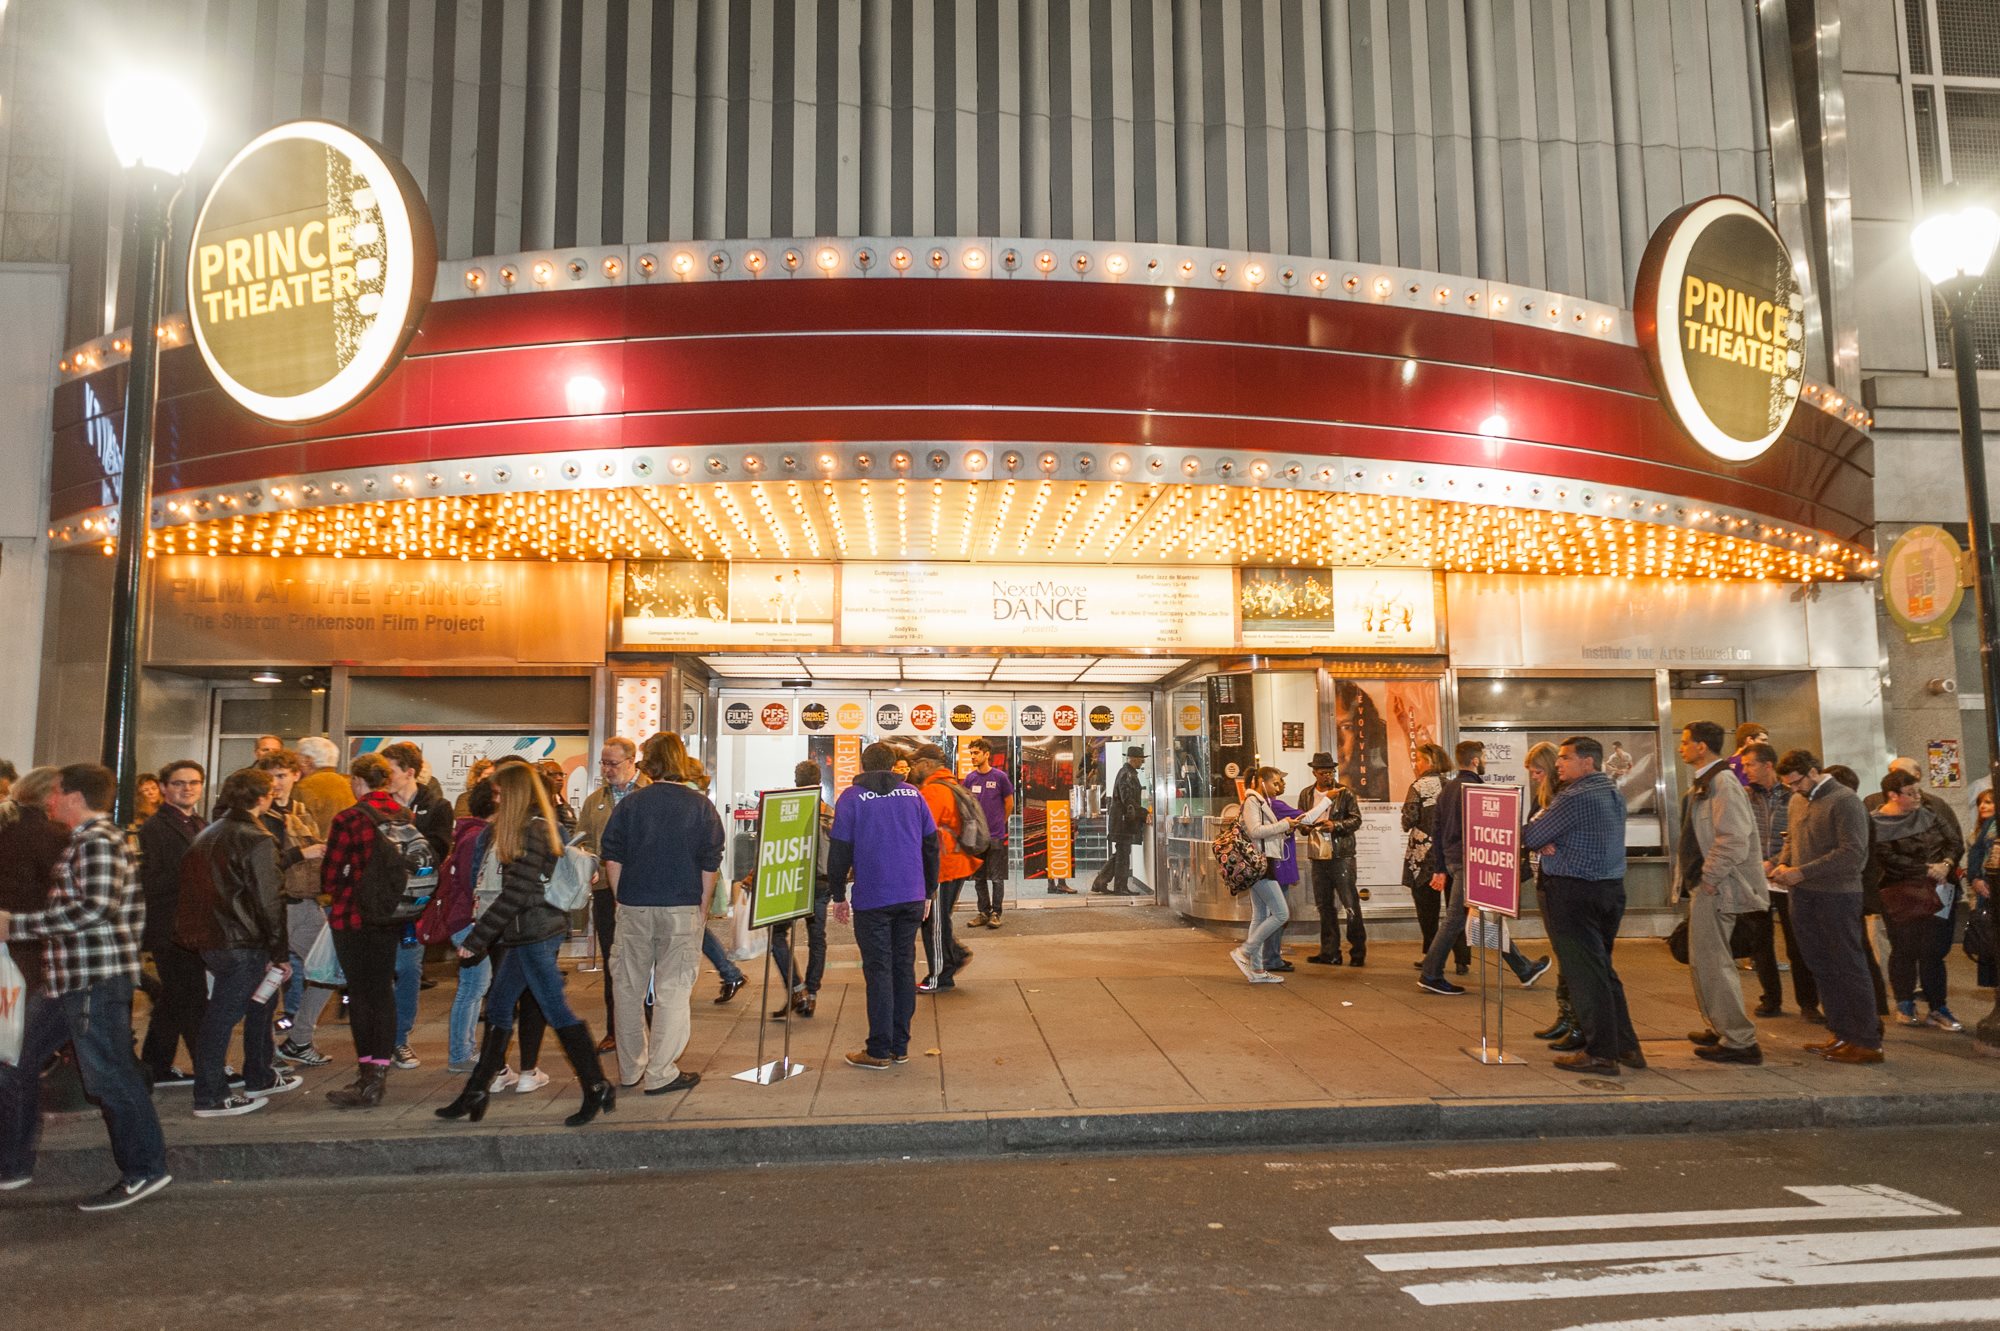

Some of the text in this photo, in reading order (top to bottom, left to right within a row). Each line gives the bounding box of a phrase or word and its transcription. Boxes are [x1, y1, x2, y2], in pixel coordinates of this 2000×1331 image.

[200, 216, 355, 292] PRINCE
[202, 265, 359, 324] THEATER
[1684, 275, 1790, 347] PRINCE
[1684, 319, 1787, 377] THEATER
[171, 578, 244, 604] FILM
[306, 580, 372, 605] THE
[383, 581, 503, 606] PRINCE
[992, 581, 1087, 598] NextMove
[993, 598, 1088, 621] DANCE
[382, 614, 419, 631] Film
[424, 614, 485, 631] Project
[1659, 646, 1686, 660] Arts
[727, 712, 748, 720] FILM
[763, 709, 785, 718] PFS
[878, 713, 898, 721] FILM
[912, 710, 933, 719] PFS
[1022, 713, 1041, 721] FILM
[1055, 710, 1074, 720] PFS
[1358, 695, 1367, 786] EVOLVING
[1408, 711, 1417, 769] LEGACY
[837, 735, 857, 800] ABARET.
[1494, 774, 1516, 783] Taylor
[858, 788, 919, 801] VOLNTEER
[780, 803, 800, 816] FILM
[1482, 800, 1500, 812] FILM
[1366, 823, 1393, 834] Onegin
[1472, 826, 1513, 846] TICKET
[1050, 804, 1069, 878] CONCERTS.
[762, 836, 812, 867] RUSH
[1469, 847, 1514, 869] HOLDER
[765, 867, 805, 898] LINE
[1479, 869, 1503, 889] LINE
